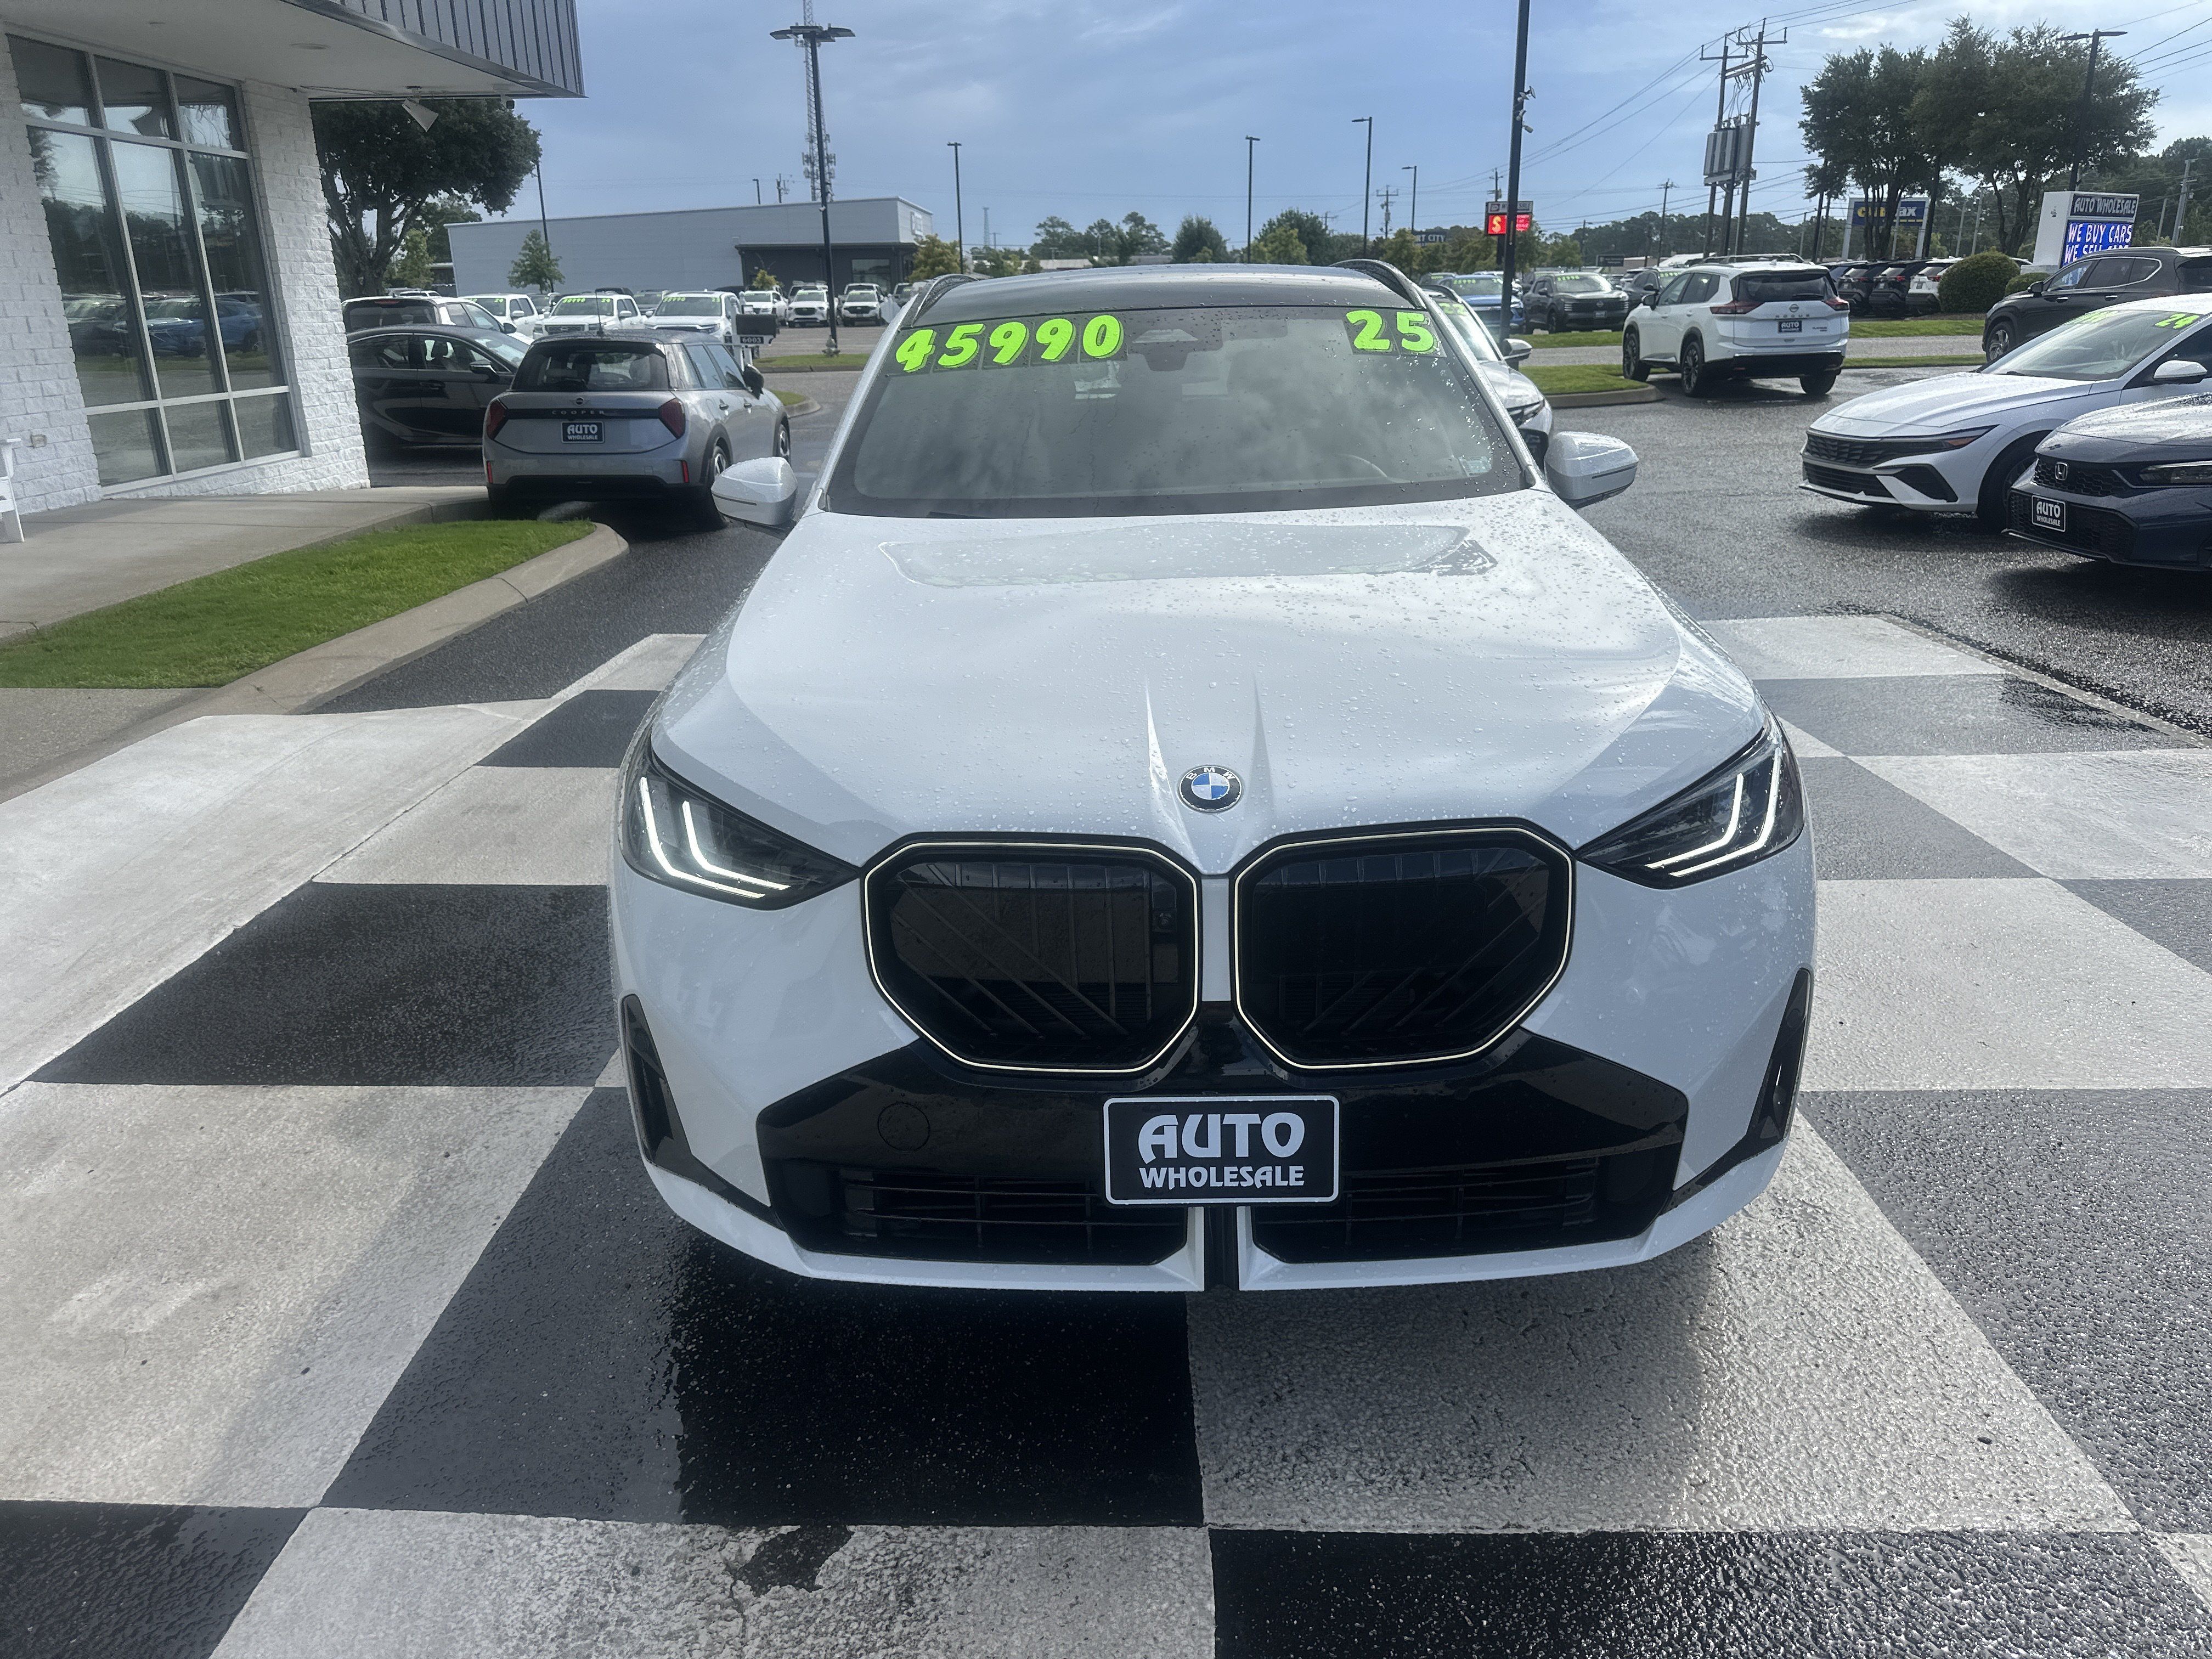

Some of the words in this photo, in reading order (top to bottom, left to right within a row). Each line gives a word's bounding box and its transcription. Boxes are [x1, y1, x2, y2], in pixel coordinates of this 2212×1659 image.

[2074, 198, 2095, 213] AUTO
[2096, 198, 2136, 215] WHOLESALE
[2068, 223, 2083, 243] WE
[2085, 224, 2106, 244] BUY
[2108, 224, 2132, 243] CARS
[2064, 244, 2080, 263] WE
[2154, 313, 2200, 329] 24
[1346, 309, 1437, 353] 25
[895, 314, 1124, 373] 45990
[567, 424, 598, 435] AUTO
[2036, 501, 2061, 518] AUTO
[2036, 515, 2061, 527] WHOLESALE
[1186, 767, 1236, 780] BMW
[1138, 1111, 1305, 1164] AUTO
[1138, 1165, 1305, 1190] WHOLESALE
